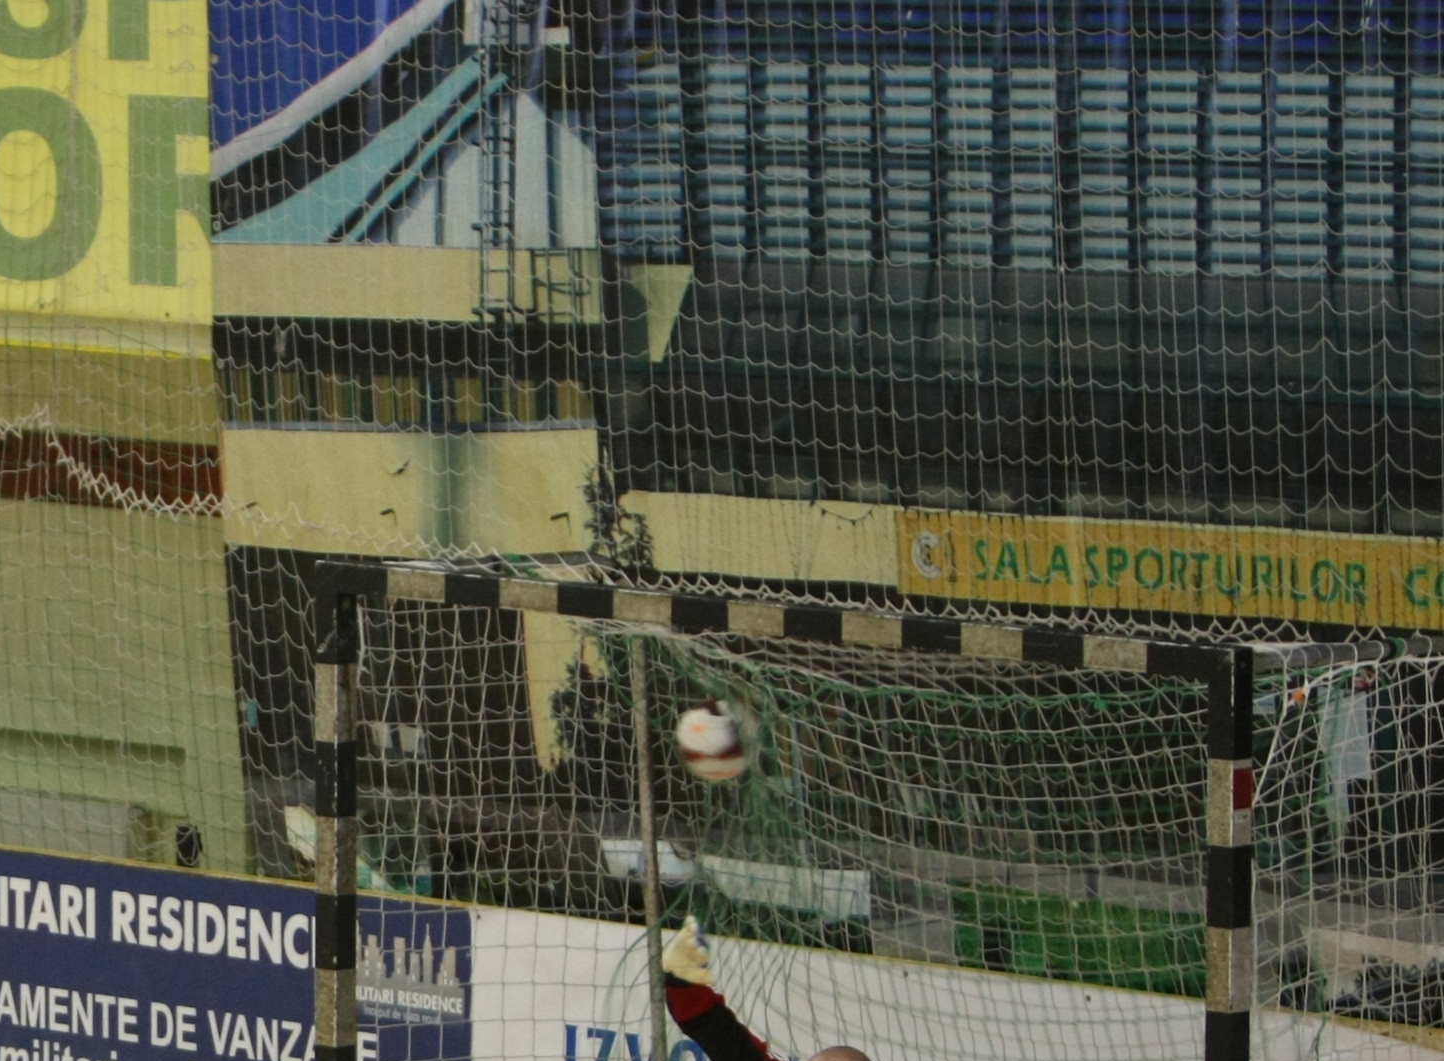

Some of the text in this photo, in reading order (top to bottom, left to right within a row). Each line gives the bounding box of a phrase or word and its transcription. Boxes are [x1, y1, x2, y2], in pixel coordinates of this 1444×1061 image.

[974, 539, 1076, 586] SALA
[1084, 544, 1369, 606] SPORTURILOR
[1404, 566, 1444, 609] C
[111, 889, 316, 970] RESIDENC
[150, 1001, 198, 1052] DE
[397, 989, 464, 1015] RESIDENCE
